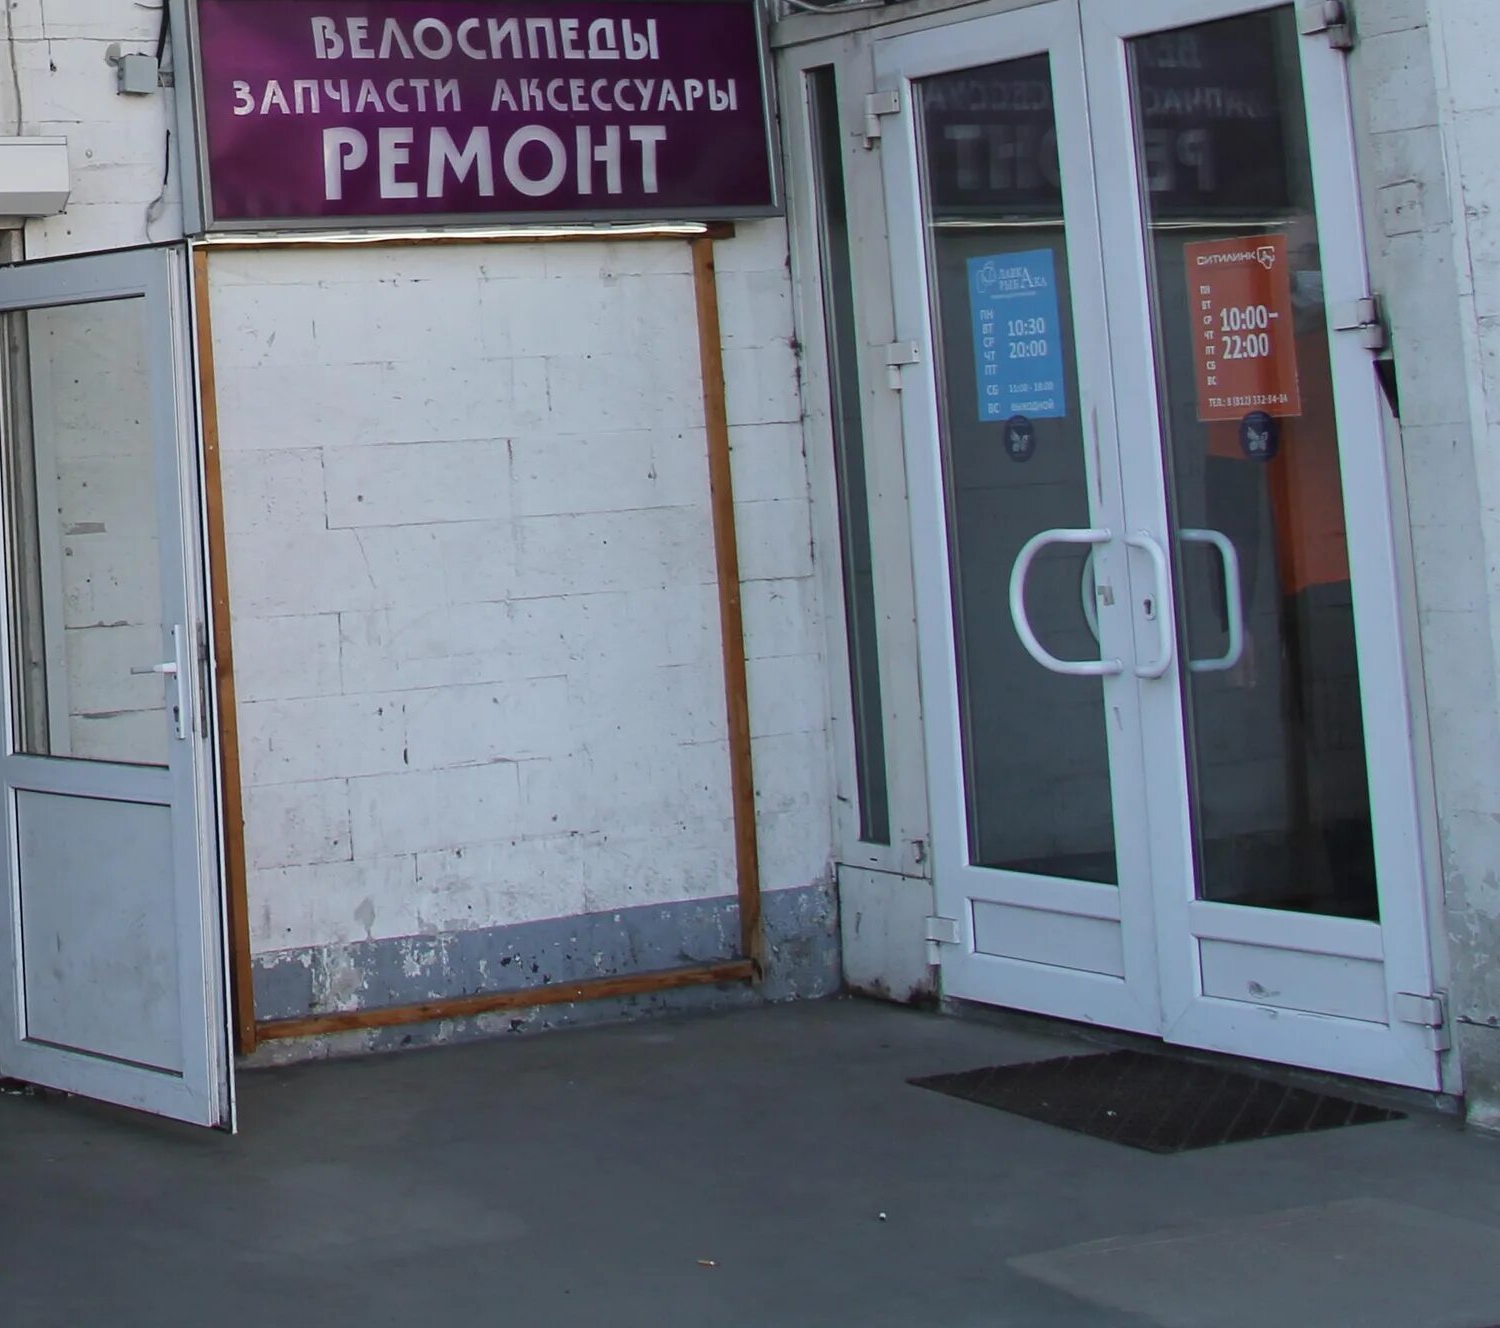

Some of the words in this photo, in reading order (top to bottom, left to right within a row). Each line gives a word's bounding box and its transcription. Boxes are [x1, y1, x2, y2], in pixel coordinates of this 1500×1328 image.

[311, 15, 660, 61] ВЕЛОСИПЕДЫ
[232, 78, 461, 115] ЗАПЧАСТИ
[492, 77, 738, 113] АКСЕССУАРЫ
[322, 124, 667, 200] РЕМОНТ
[1008, 317, 1046, 337] 10:30
[1009, 339, 1047, 359] 20:00
[1221, 333, 1269, 360] 22:00
